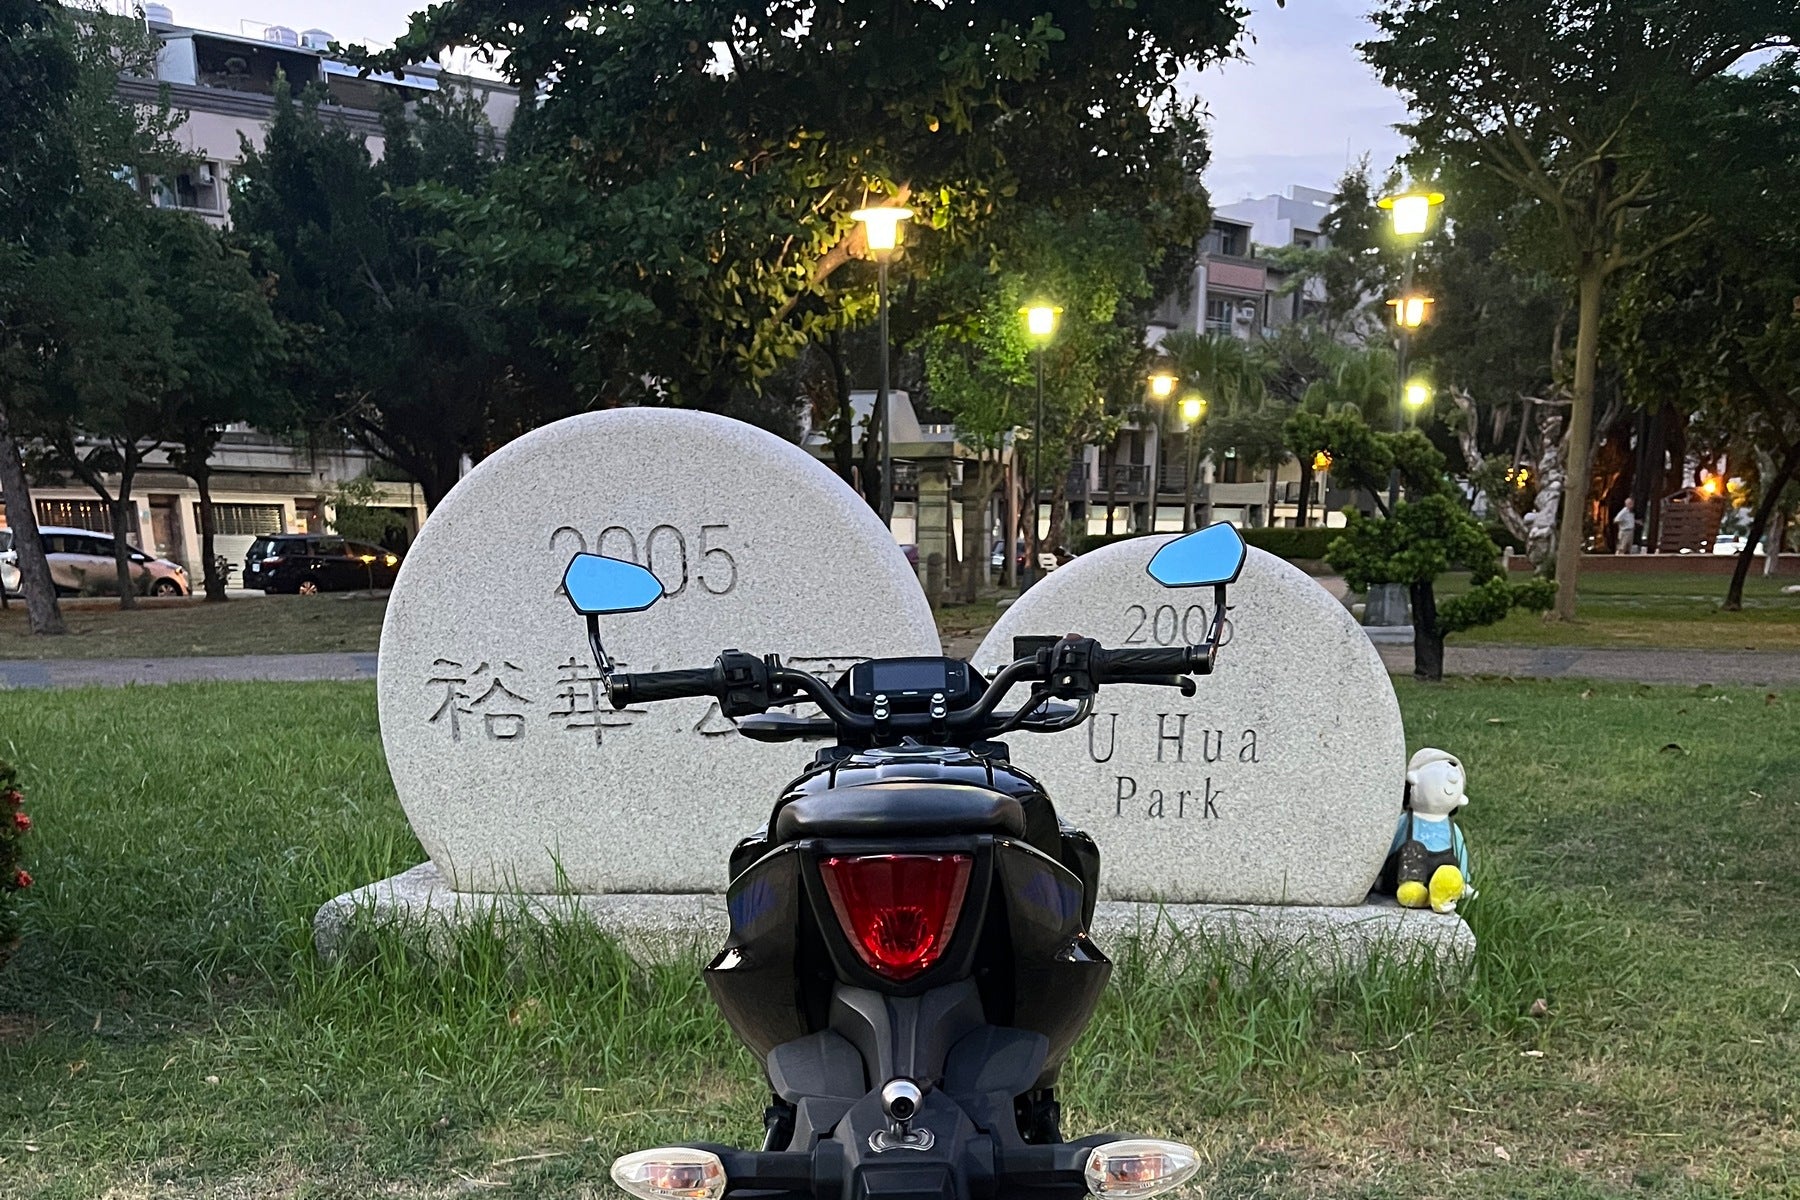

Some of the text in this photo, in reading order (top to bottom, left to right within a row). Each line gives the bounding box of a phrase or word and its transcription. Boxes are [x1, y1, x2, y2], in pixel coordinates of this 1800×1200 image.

[426, 656, 874, 747] 裕華
[1156, 713, 1260, 763] Hua
[1115, 776, 1224, 819] Park
